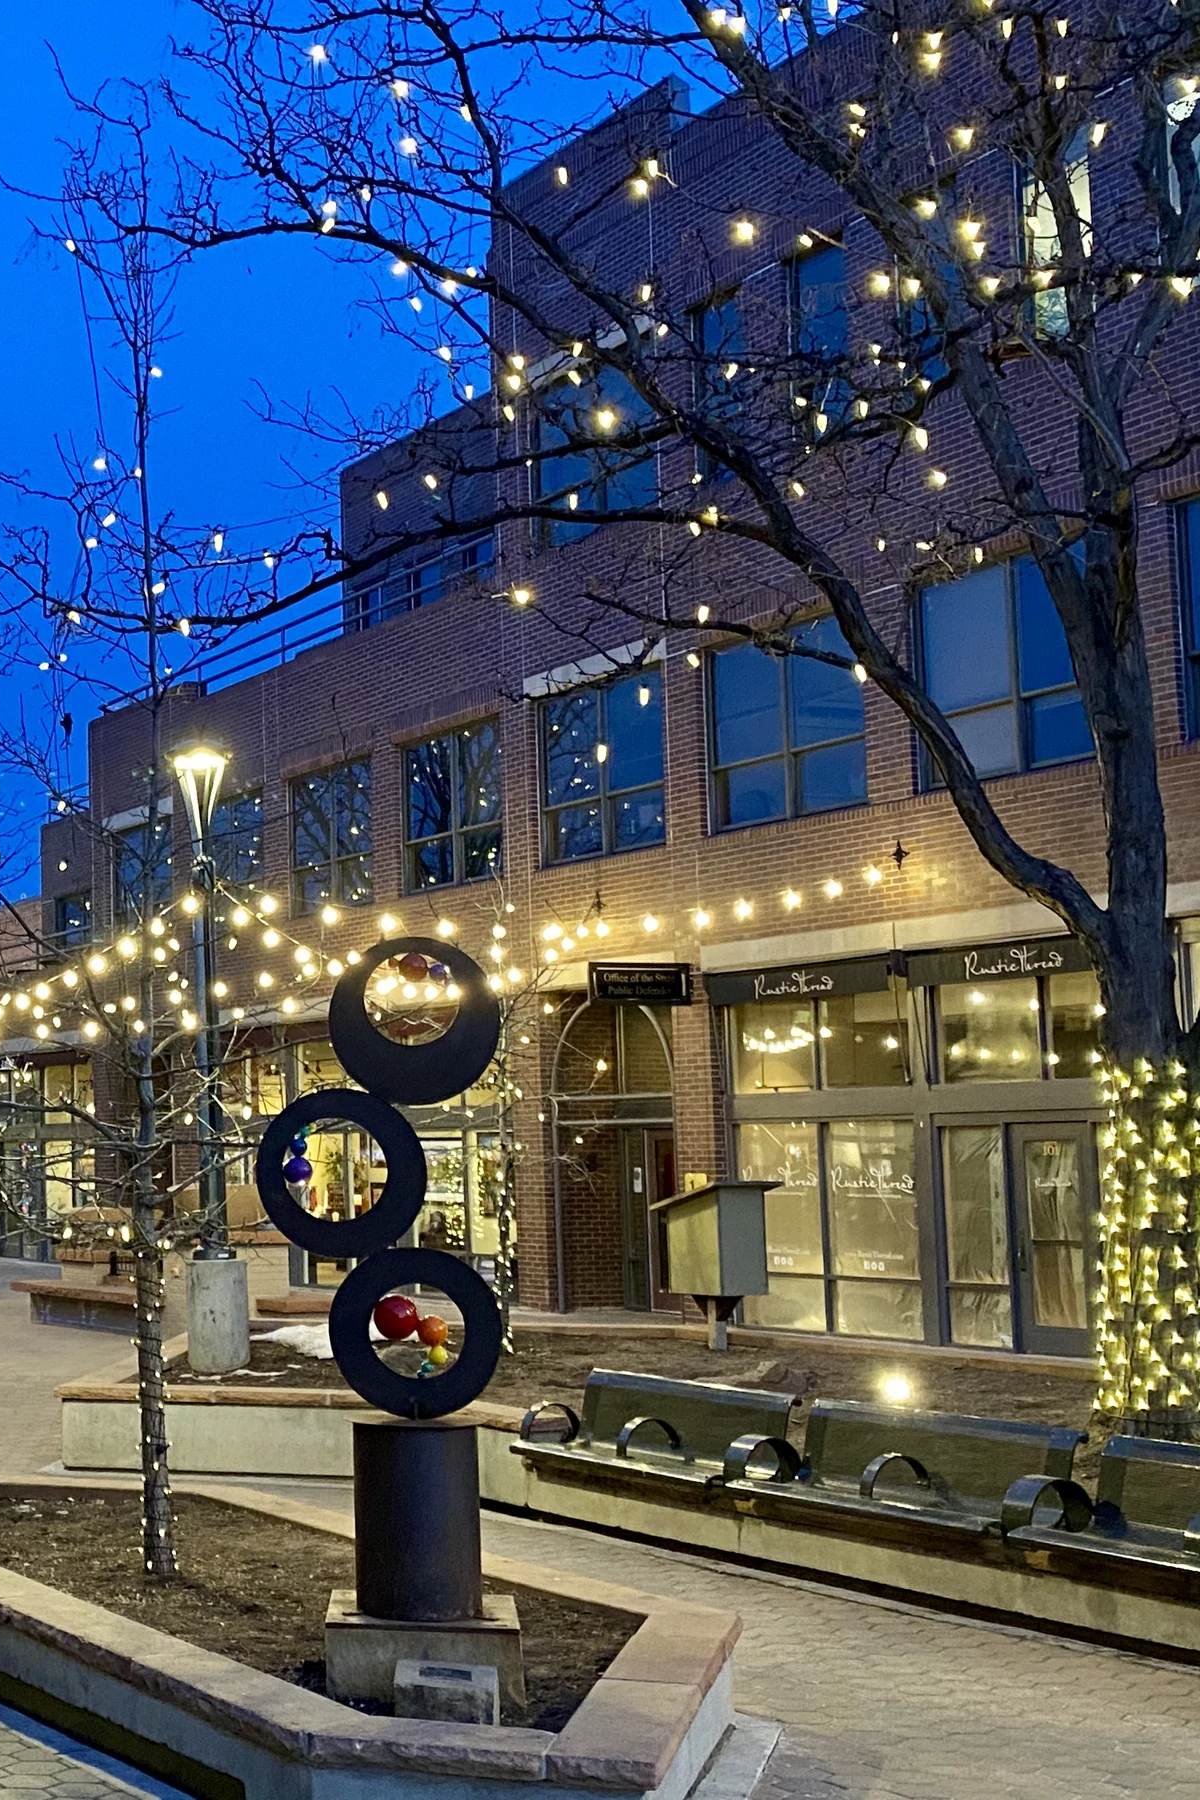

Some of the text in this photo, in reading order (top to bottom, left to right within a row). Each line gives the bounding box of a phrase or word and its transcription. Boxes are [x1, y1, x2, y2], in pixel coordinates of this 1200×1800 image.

[603, 972, 629, 983] Office
[630, 973, 640, 983] of
[641, 973, 653, 982] the
[608, 986, 672, 995] Public Defender
[1042, 1145, 1060, 1156] 101
